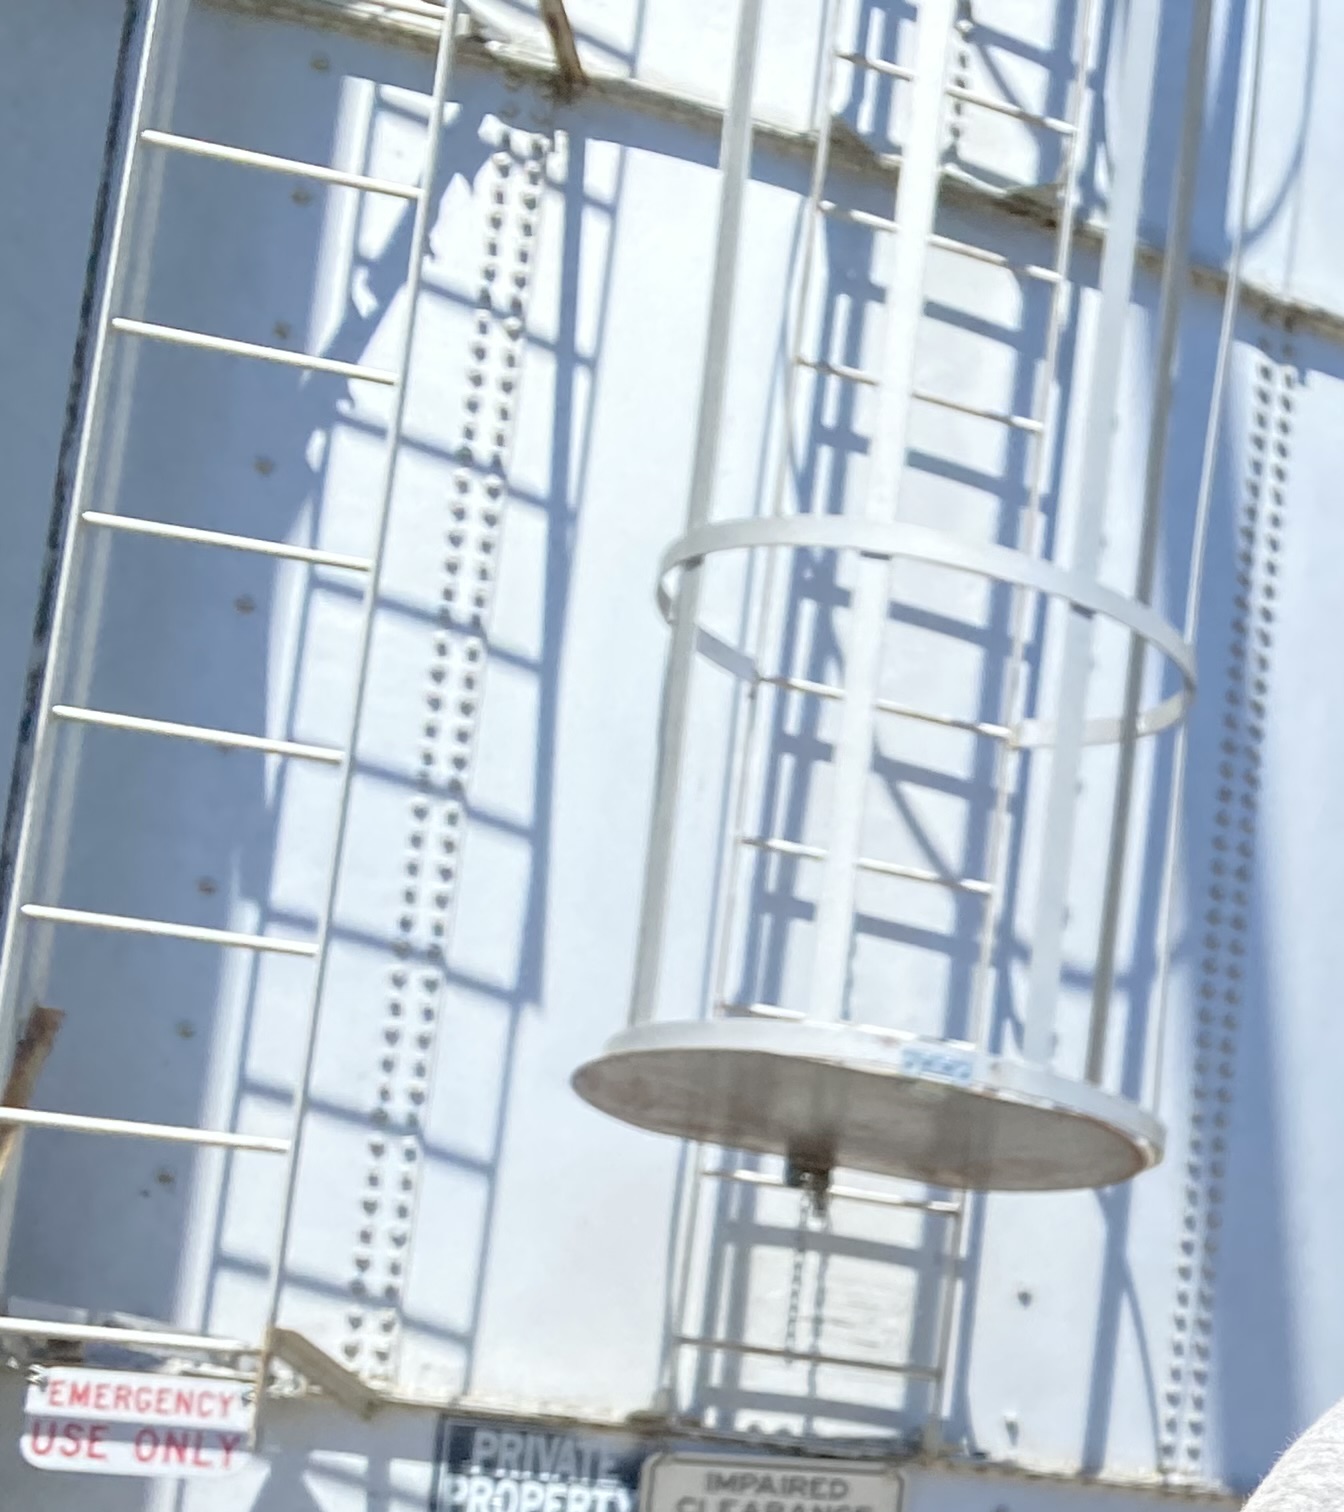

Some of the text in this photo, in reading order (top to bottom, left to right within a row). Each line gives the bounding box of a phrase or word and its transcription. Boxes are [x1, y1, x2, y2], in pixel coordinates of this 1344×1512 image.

[48, 1379, 237, 1418] EMERGENCY
[31, 1420, 241, 1468] USE ONLY
[705, 1472, 849, 1500] IMPAIRED
